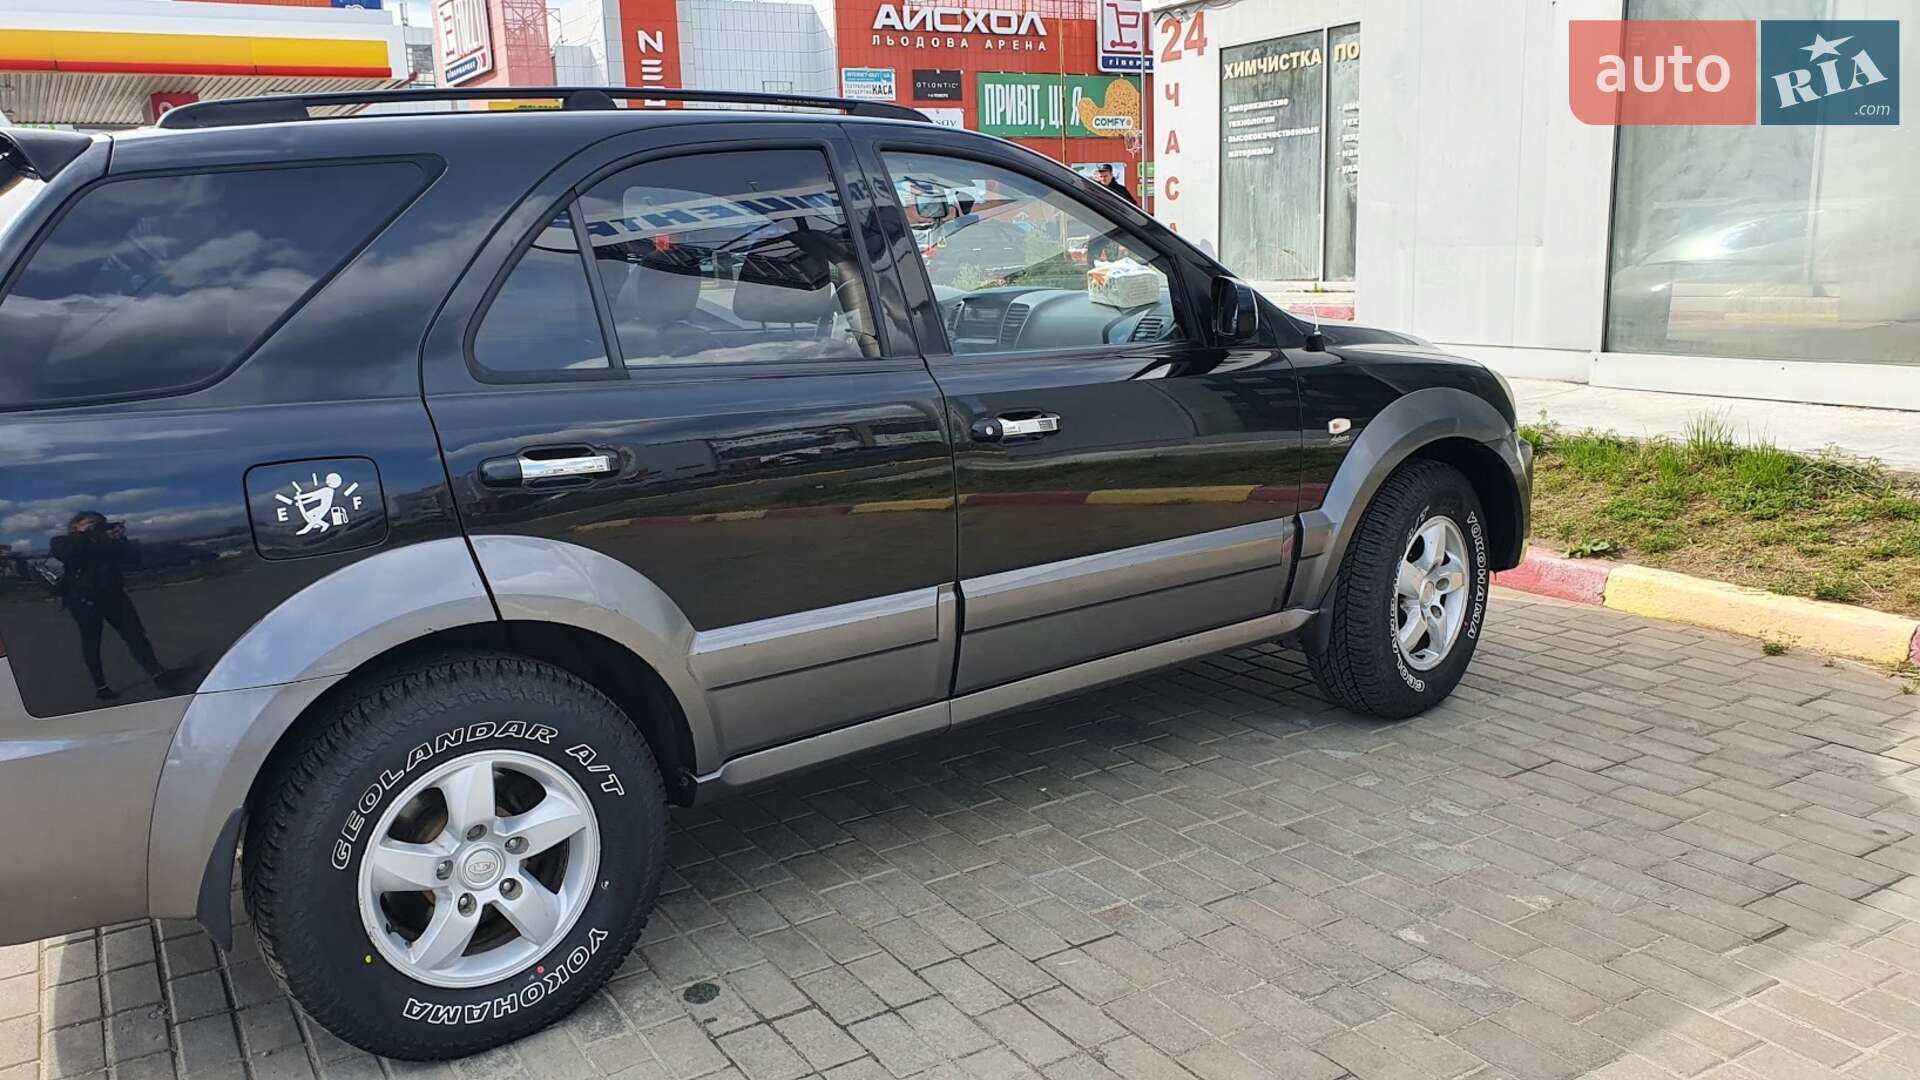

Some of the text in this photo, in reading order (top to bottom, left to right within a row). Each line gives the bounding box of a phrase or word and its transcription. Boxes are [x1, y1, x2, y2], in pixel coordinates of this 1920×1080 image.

[872, 35, 1047, 51] ЛЬОДОВА АРЕНА
[1160, 11, 1208, 63] 24
[1223, 48, 1322, 80] ХИМЧИСТКА
[984, 83, 1045, 130] ПРИВІТ,
[1094, 118, 1126, 126] COMFY
[276, 507, 289, 522] E
[352, 496, 362, 510] F
[1466, 511, 1489, 640] YOKOHAMA
[331, 720, 625, 870] GEOLANDAR A/T
[403, 927, 609, 1025] YOKOHAMA
